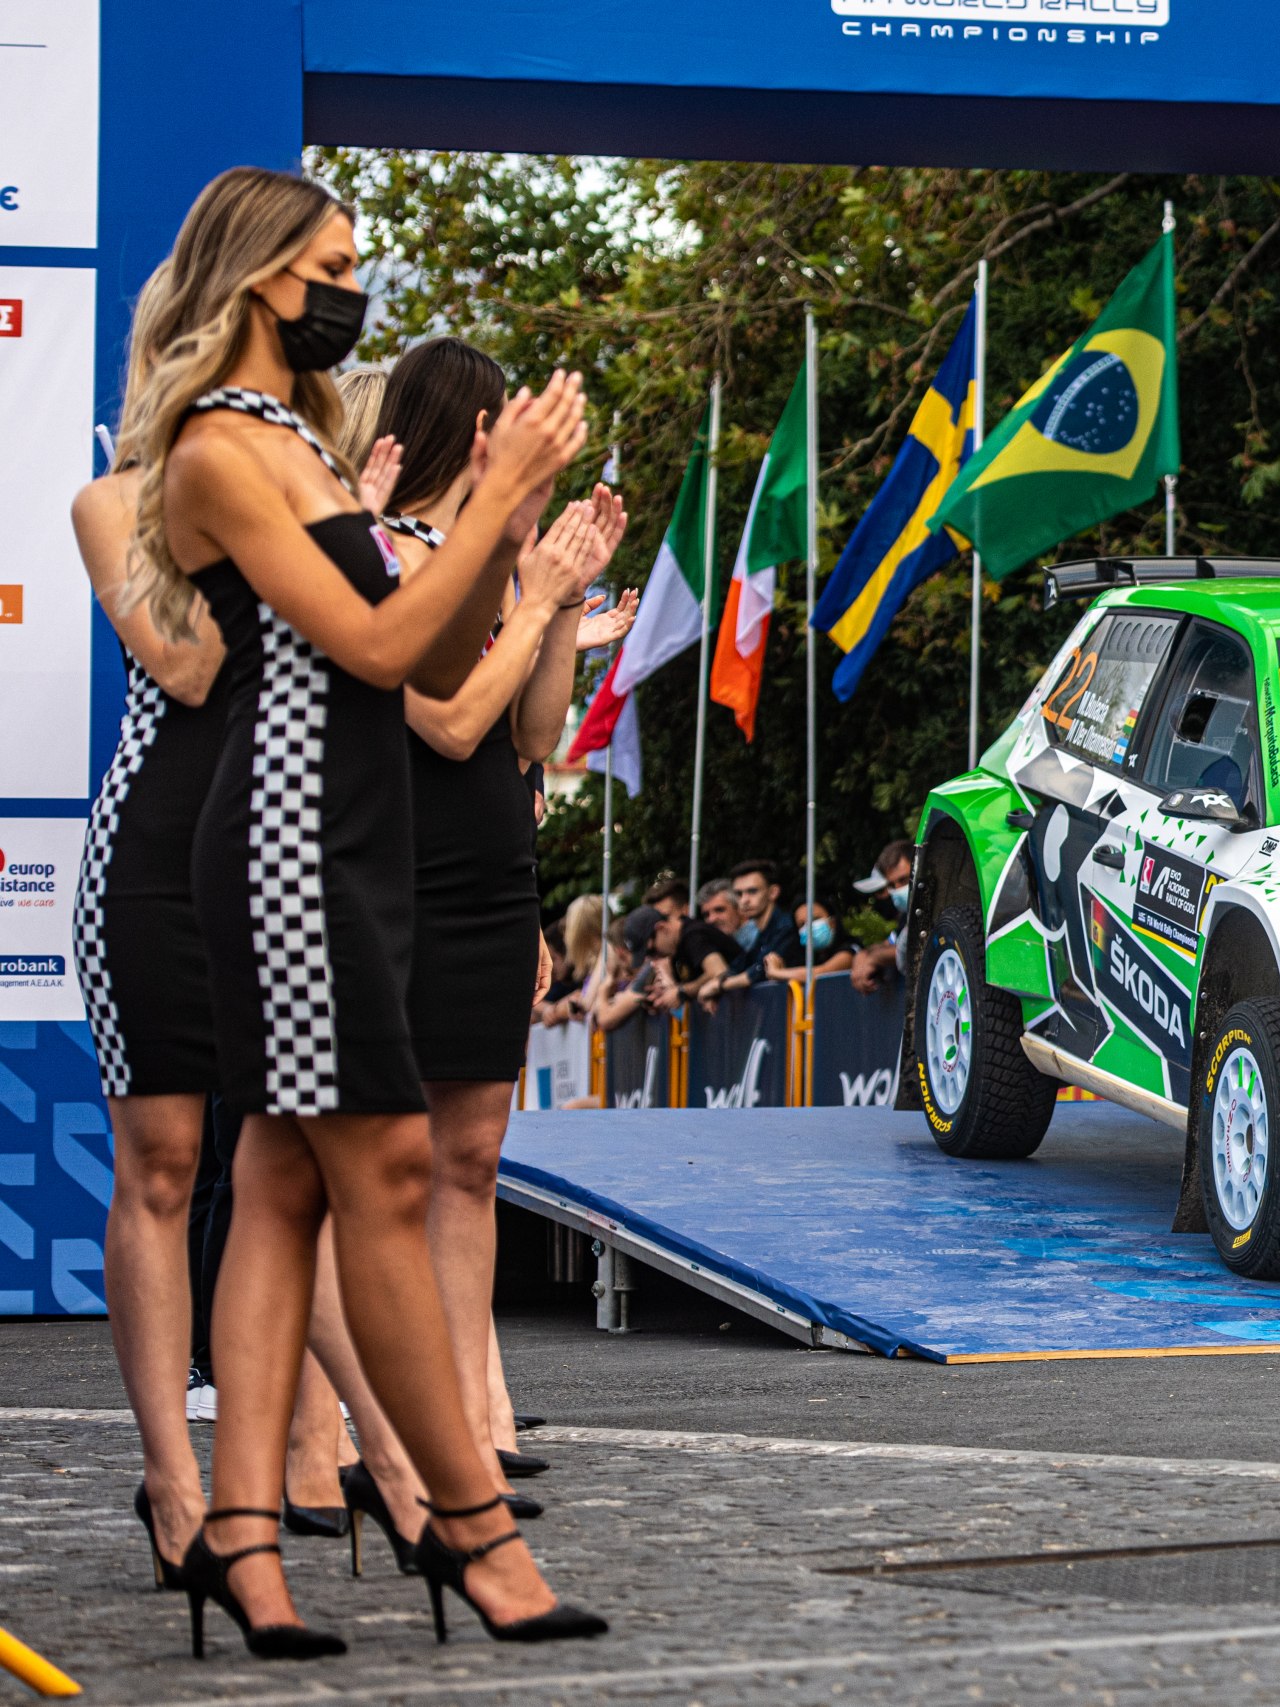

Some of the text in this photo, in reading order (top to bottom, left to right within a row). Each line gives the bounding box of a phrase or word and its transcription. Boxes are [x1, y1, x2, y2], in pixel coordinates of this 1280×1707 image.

[841, 21, 1159, 45] CHAMPIONSHIP
[8, 863, 55, 879] europ
[1170, 870, 1181, 881] EKO
[1110, 933, 1186, 1049] ŠKODA
[1206, 1028, 1252, 1093] SCORPION
[917, 1061, 953, 1132] SCORPION
